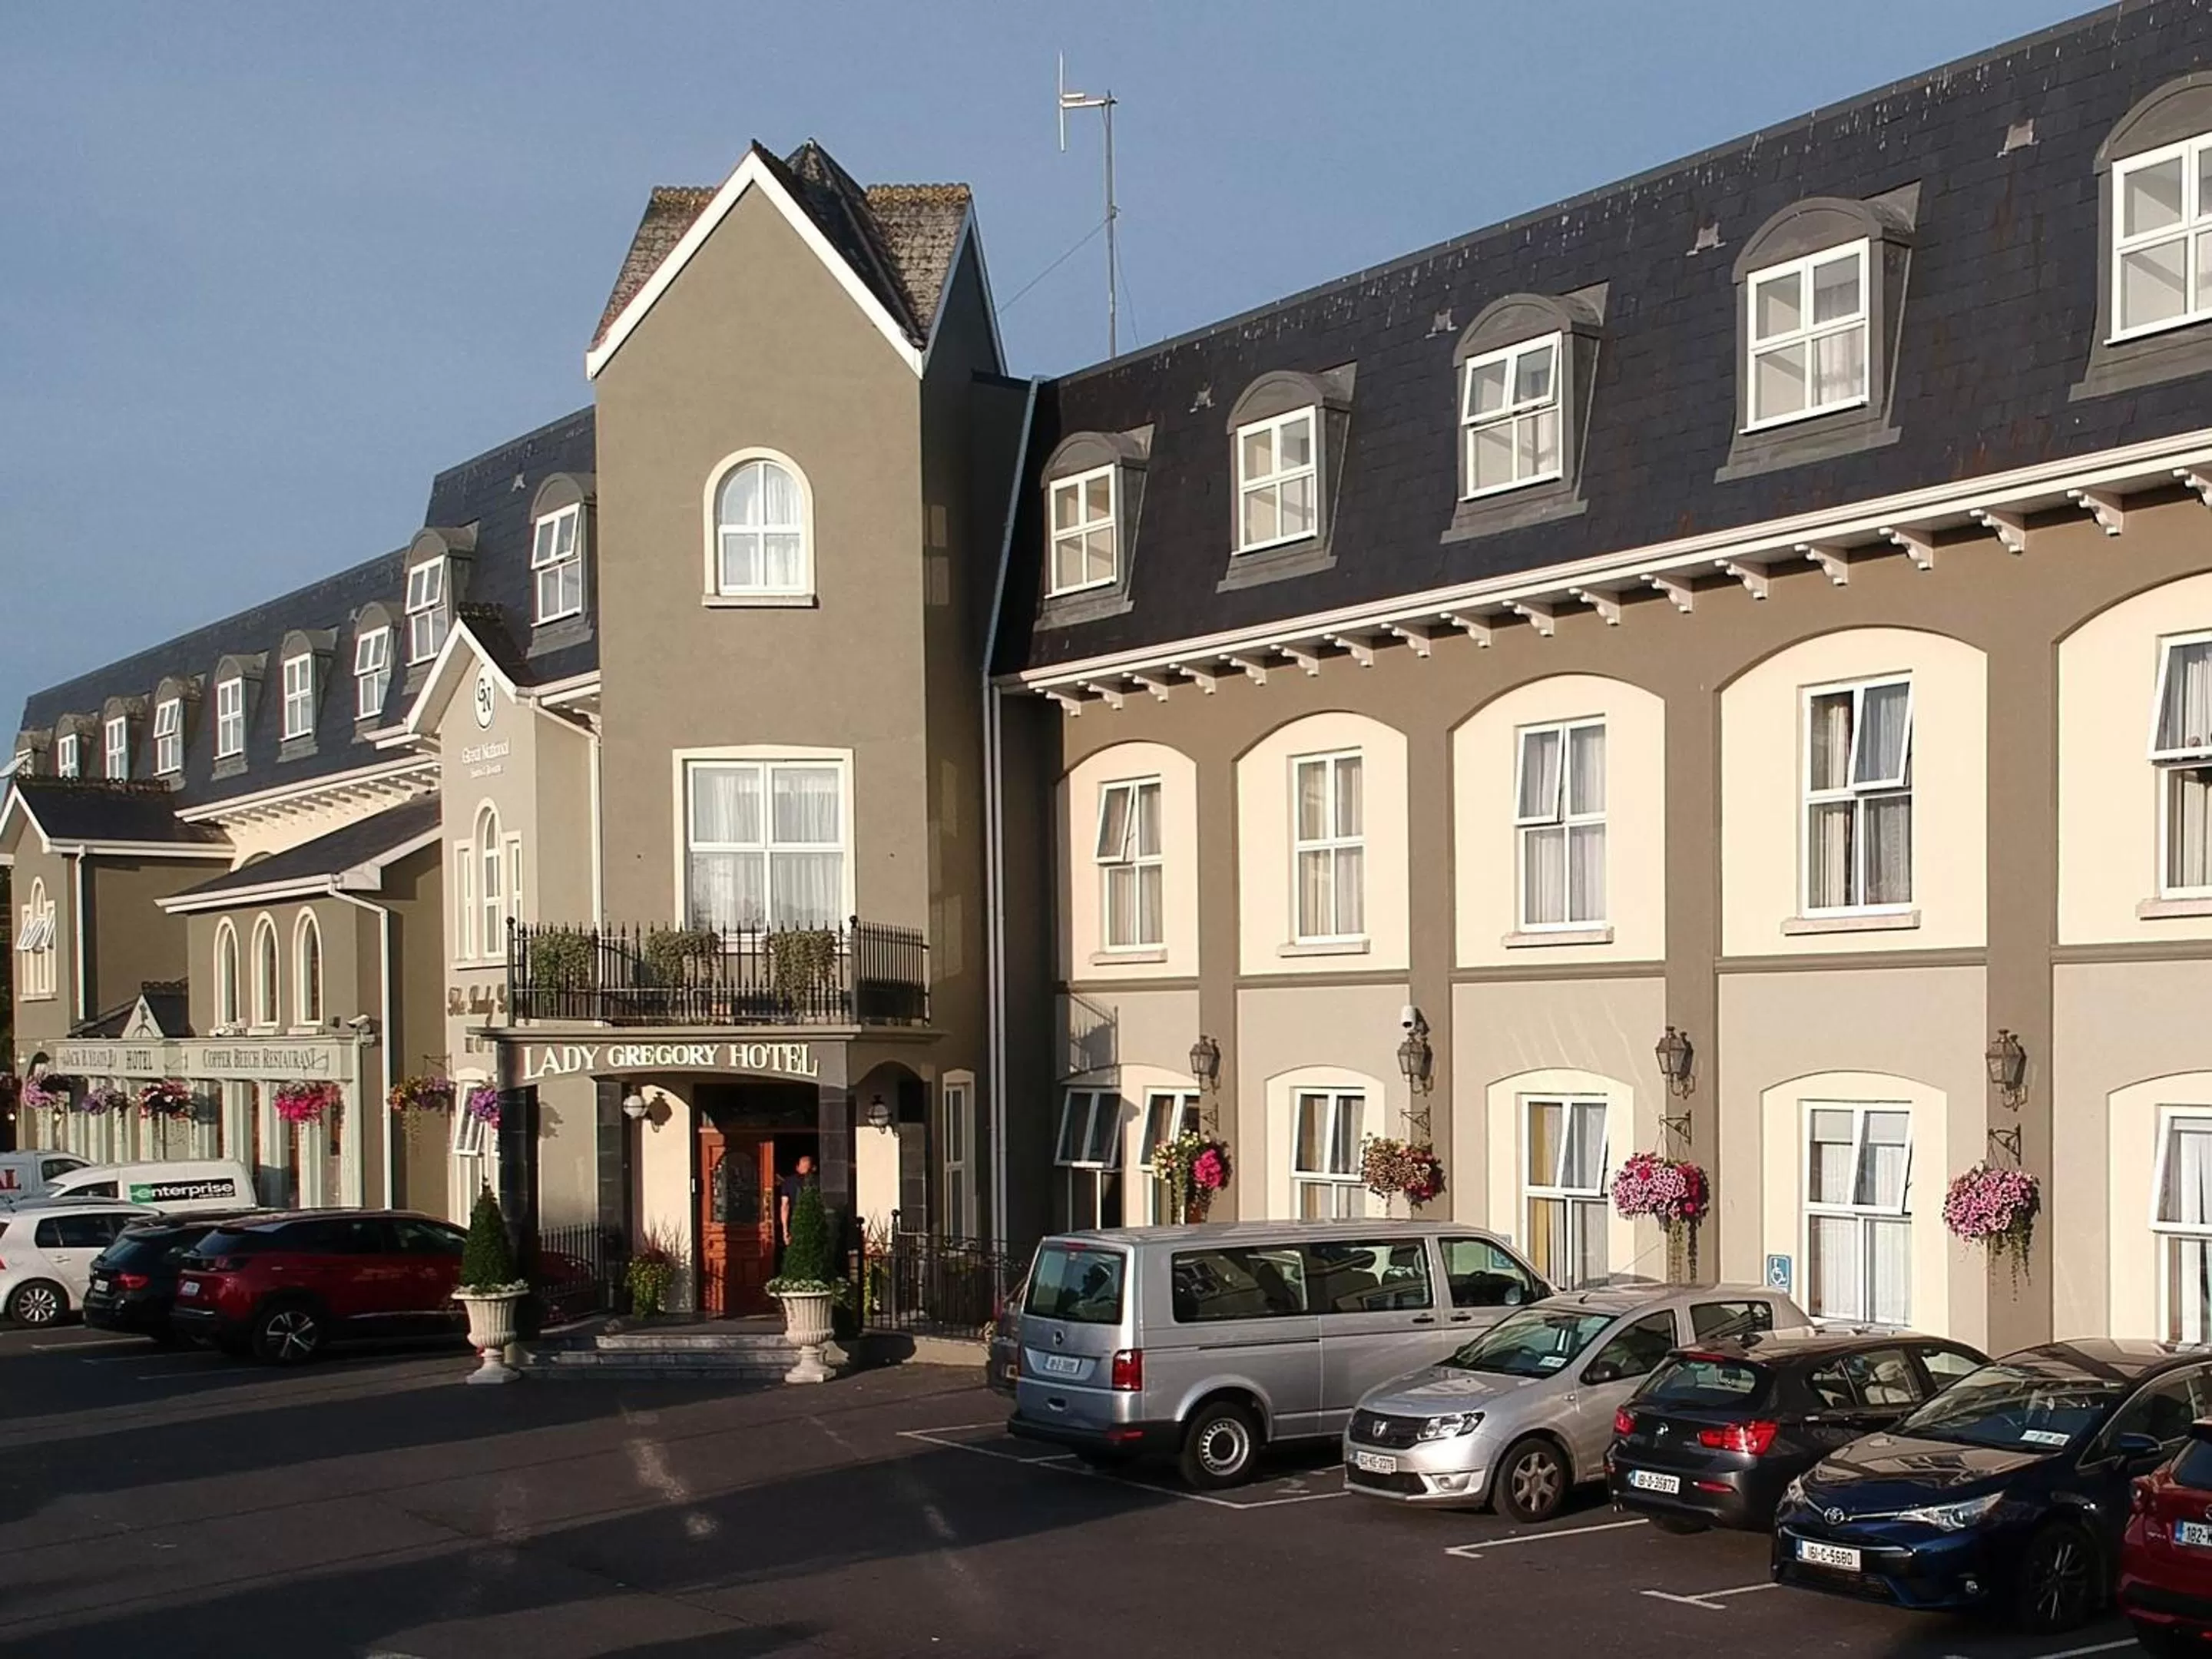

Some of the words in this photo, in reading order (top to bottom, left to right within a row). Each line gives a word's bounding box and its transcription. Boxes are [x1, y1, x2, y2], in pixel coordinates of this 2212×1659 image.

[126, 1049, 152, 1070] HOTEL
[203, 1048, 231, 1068] COPPER
[233, 1048, 260, 1068] BEECH
[522, 1045, 600, 1080] LADY
[607, 1044, 720, 1068] GREGORY
[729, 1042, 819, 1077] HOTEL
[131, 1183, 233, 1201] enterprise
